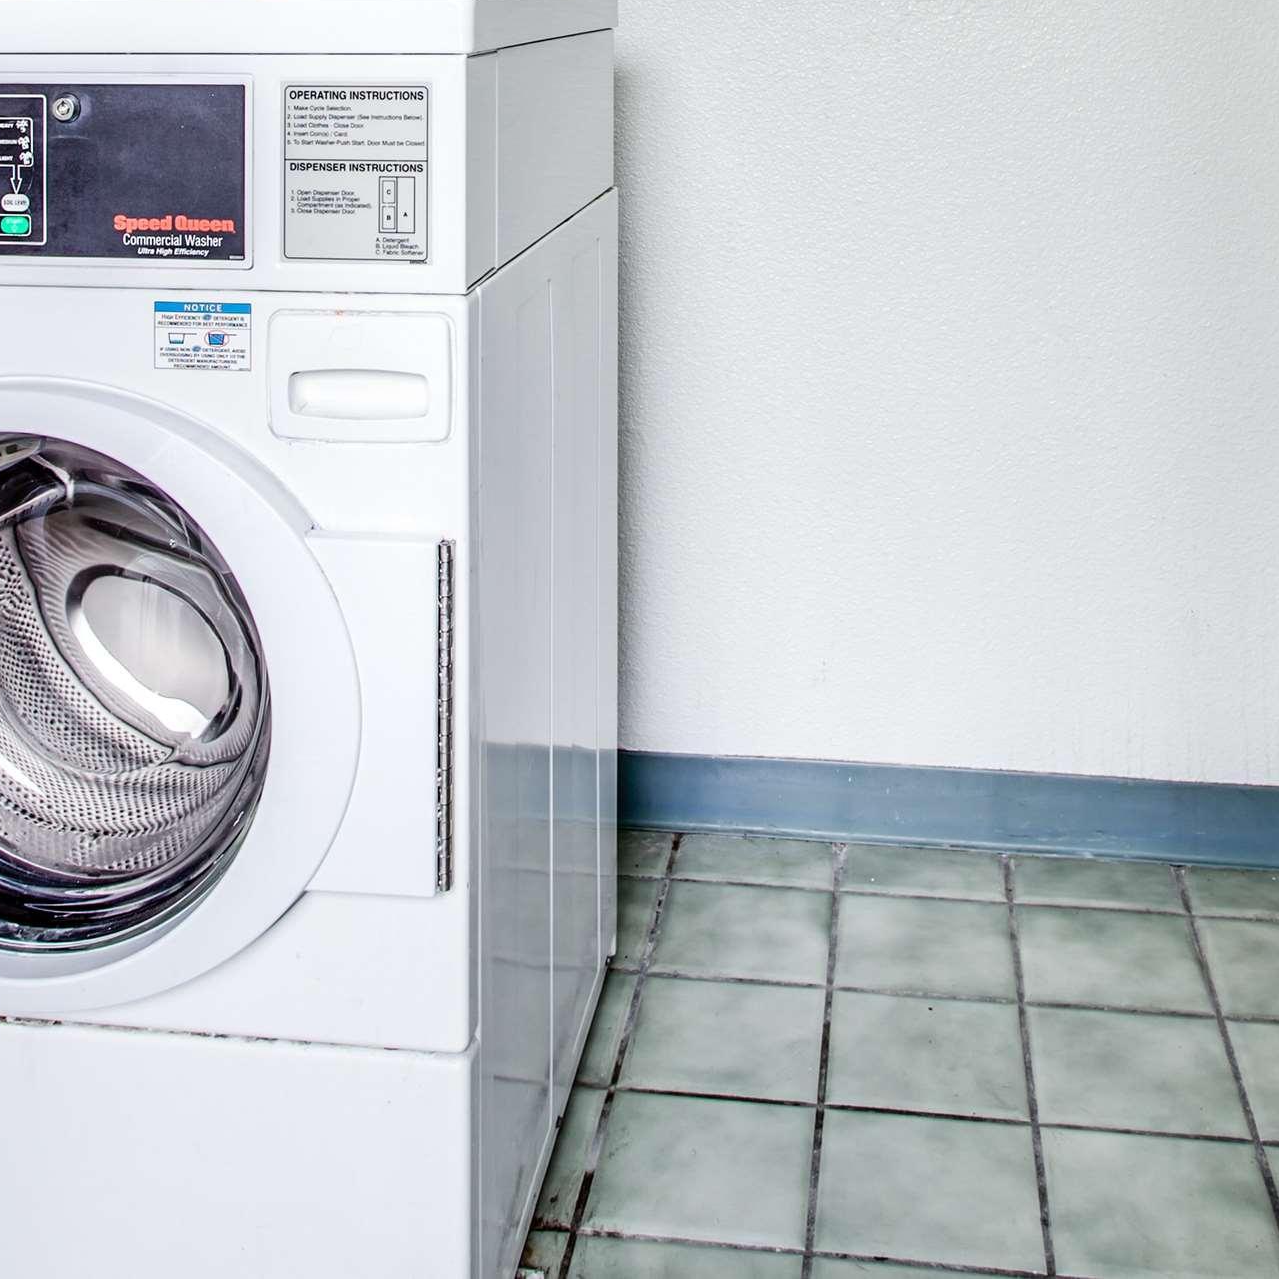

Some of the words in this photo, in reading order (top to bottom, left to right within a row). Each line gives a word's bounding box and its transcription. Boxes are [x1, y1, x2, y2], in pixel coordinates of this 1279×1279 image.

[289, 90, 347, 100] OPERATING
[349, 91, 424, 100] INSTRUCTIONS
[290, 163, 346, 171] DISPENSER
[349, 163, 423, 172] INSTRUCTIONS
[113, 214, 172, 233] Speed
[175, 215, 235, 232] Queen
[123, 233, 183, 247] Commercial
[184, 234, 223, 247] Washer
[156, 248, 173, 256] High
[174, 248, 210, 257] Efficiency
[184, 304, 222, 312] NOTICE
